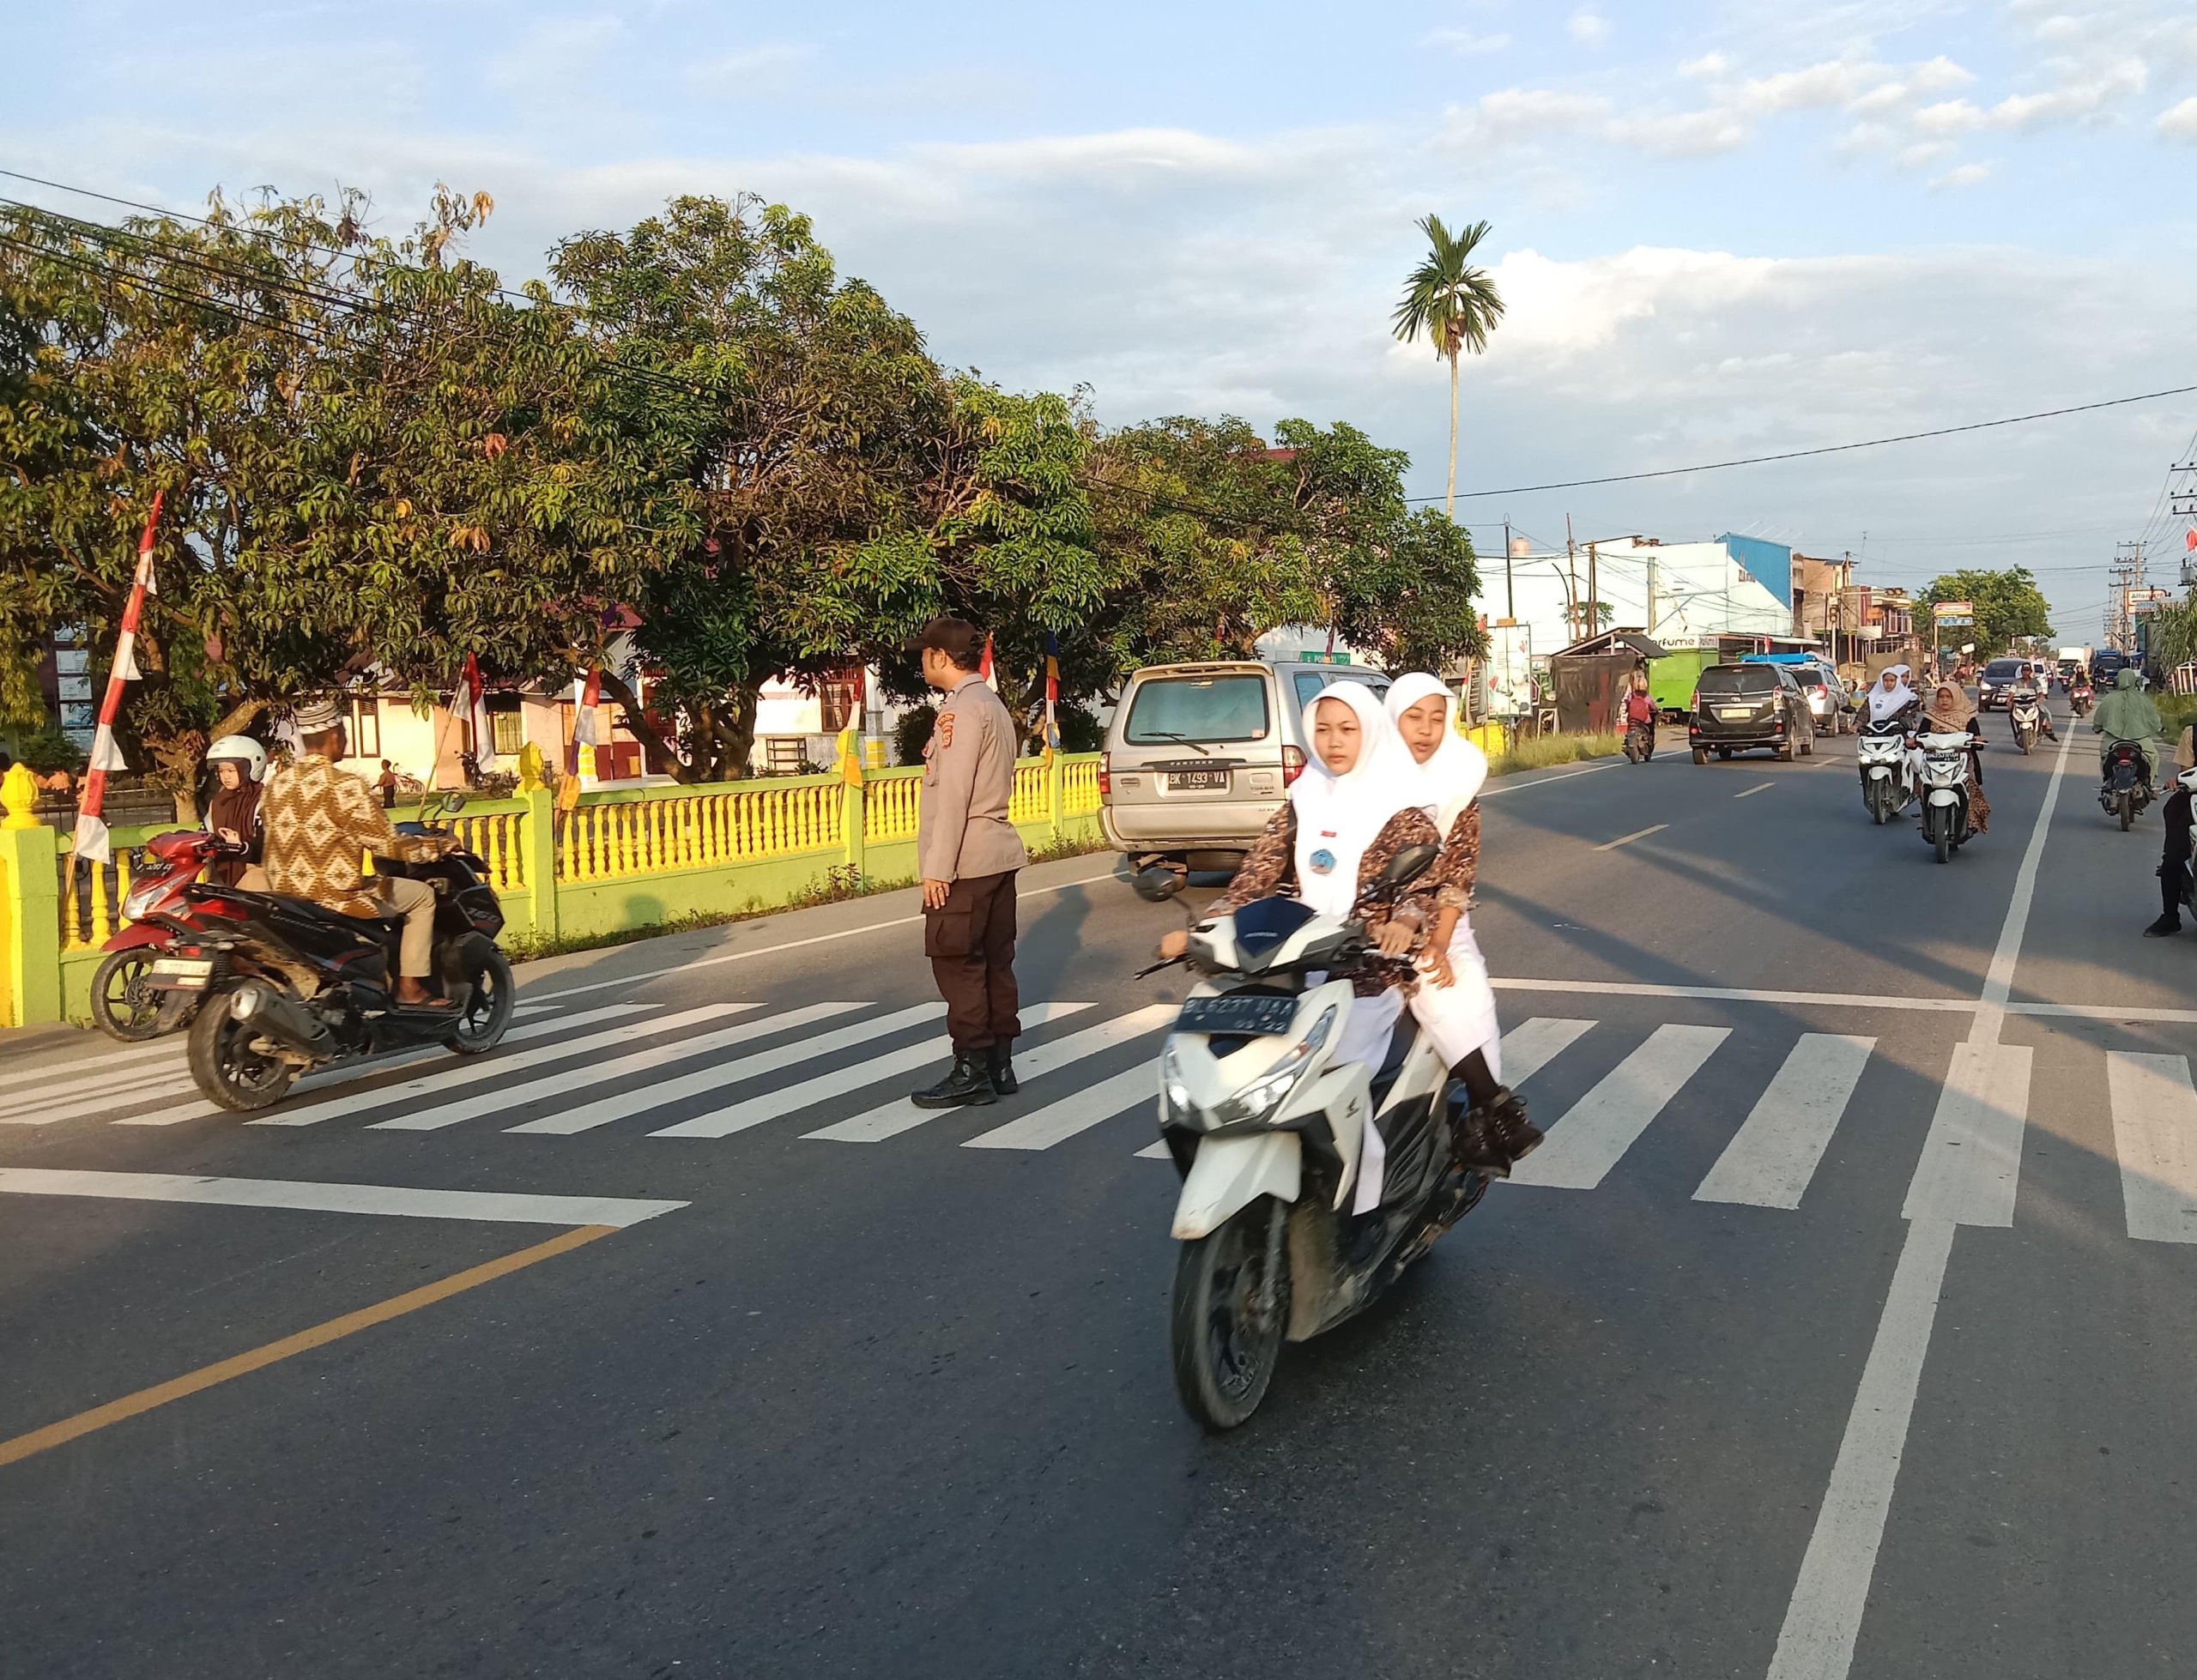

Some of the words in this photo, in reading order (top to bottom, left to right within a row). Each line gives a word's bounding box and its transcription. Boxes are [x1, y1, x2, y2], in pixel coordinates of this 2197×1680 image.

[1169, 773, 1181, 784] BK
[1187, 772, 1208, 784] 1493
[1213, 771, 1226, 783] VA
